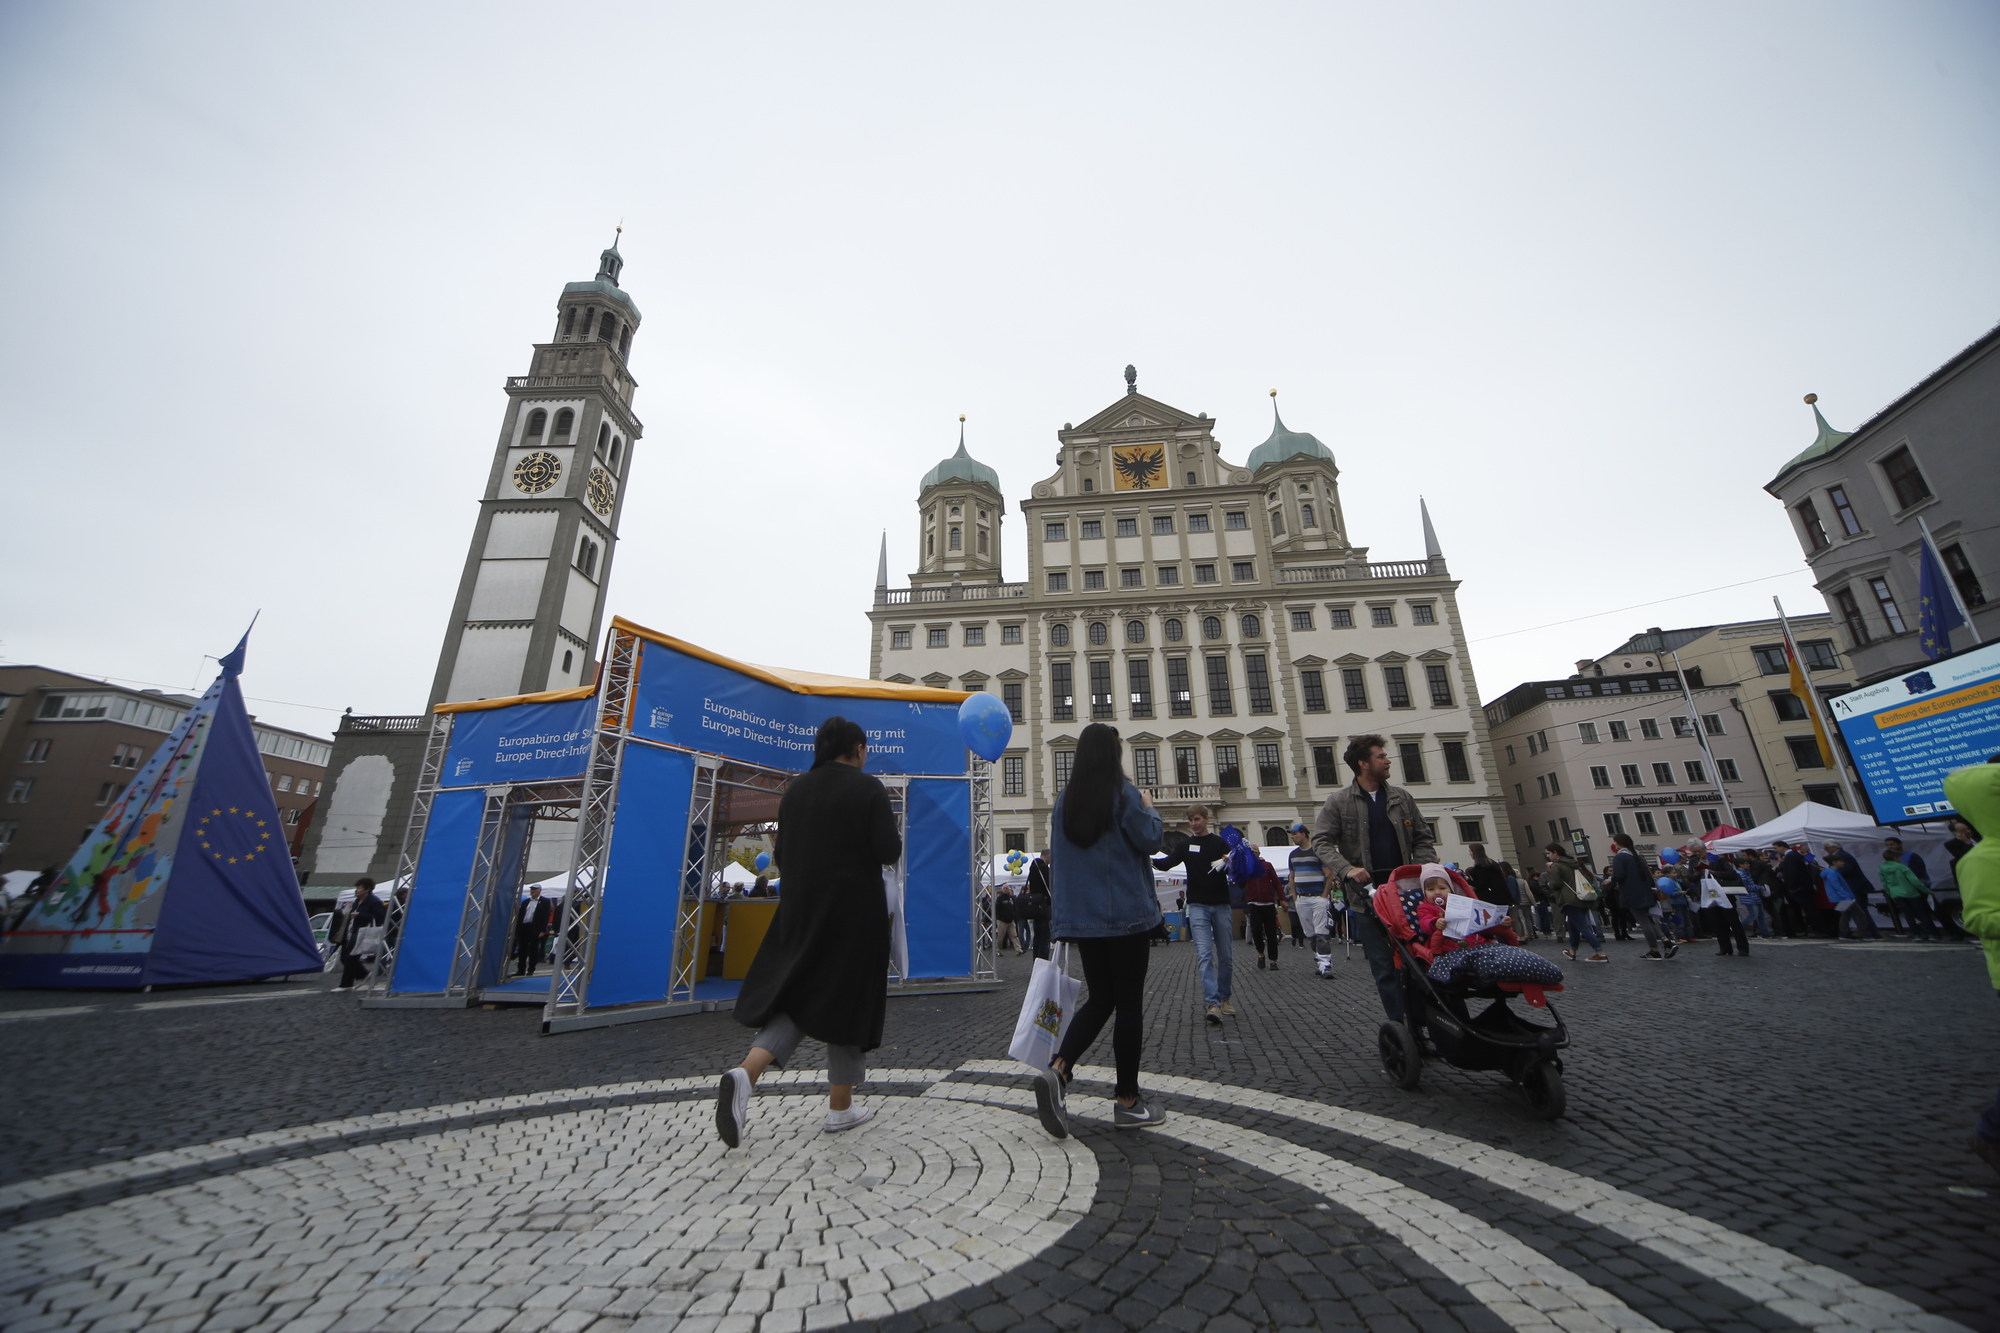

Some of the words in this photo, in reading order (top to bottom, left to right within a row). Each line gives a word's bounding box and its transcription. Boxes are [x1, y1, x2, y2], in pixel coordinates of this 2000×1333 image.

[1849, 693, 1862, 702] Stadt
[1863, 685, 1890, 697] Augsburg
[1881, 709, 1918, 724] Eröffnung
[1918, 705, 1931, 714] der
[1931, 688, 1989, 709] Europawoche
[702, 715, 740, 736] Europe
[704, 698, 766, 726] Europabüro
[769, 719, 785, 731] der
[788, 723, 818, 736] Stadt
[885, 728, 905, 739] mit
[498, 733, 560, 747] Europabüro
[563, 731, 579, 741] der
[496, 752, 532, 763] Europe
[1928, 757, 1944, 766] BEST
[1620, 795, 1673, 806] Augsburger
[1675, 792, 1724, 804] Allgemein
